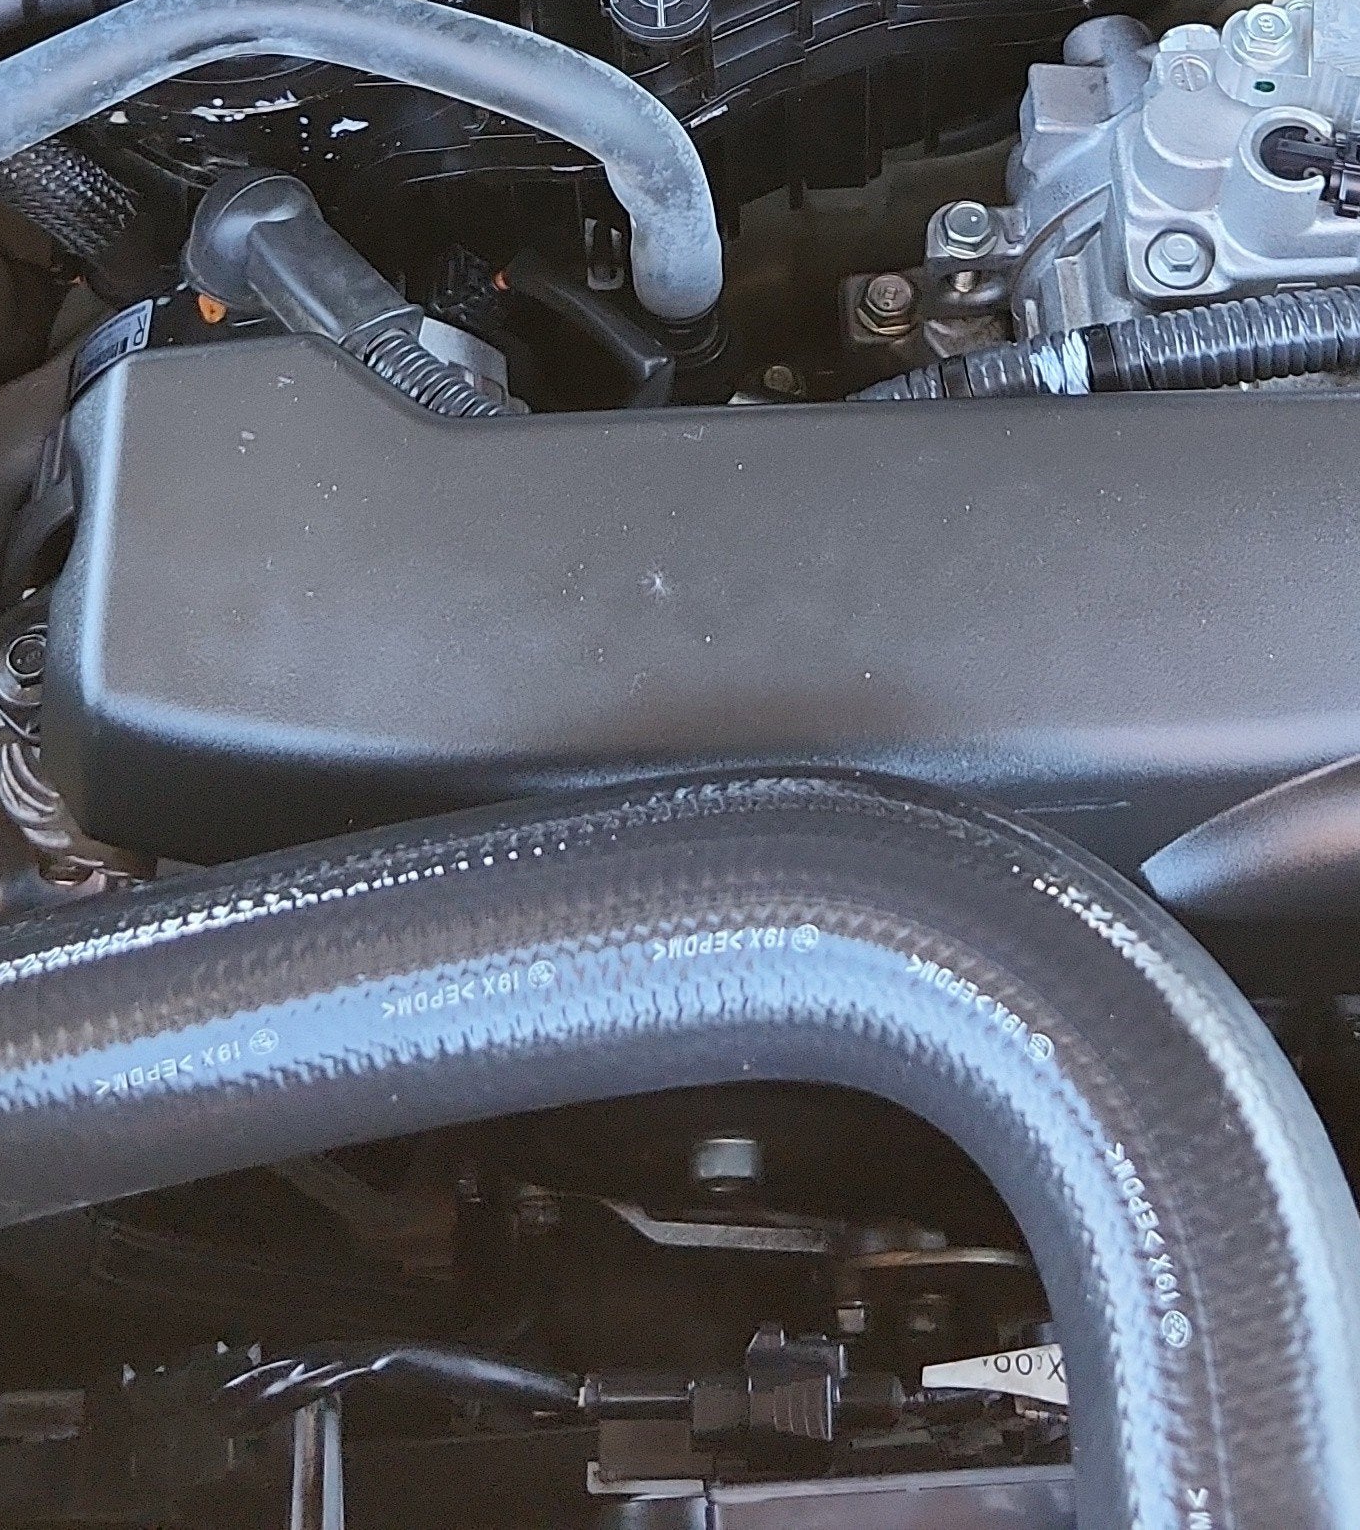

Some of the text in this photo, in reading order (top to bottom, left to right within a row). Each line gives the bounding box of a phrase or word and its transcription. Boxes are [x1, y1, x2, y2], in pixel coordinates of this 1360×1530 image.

[747, 926, 787, 949] 19X
[480, 968, 519, 998] 19X
[200, 1039, 242, 1067] 19X
[1145, 1254, 1181, 1304] 19X
